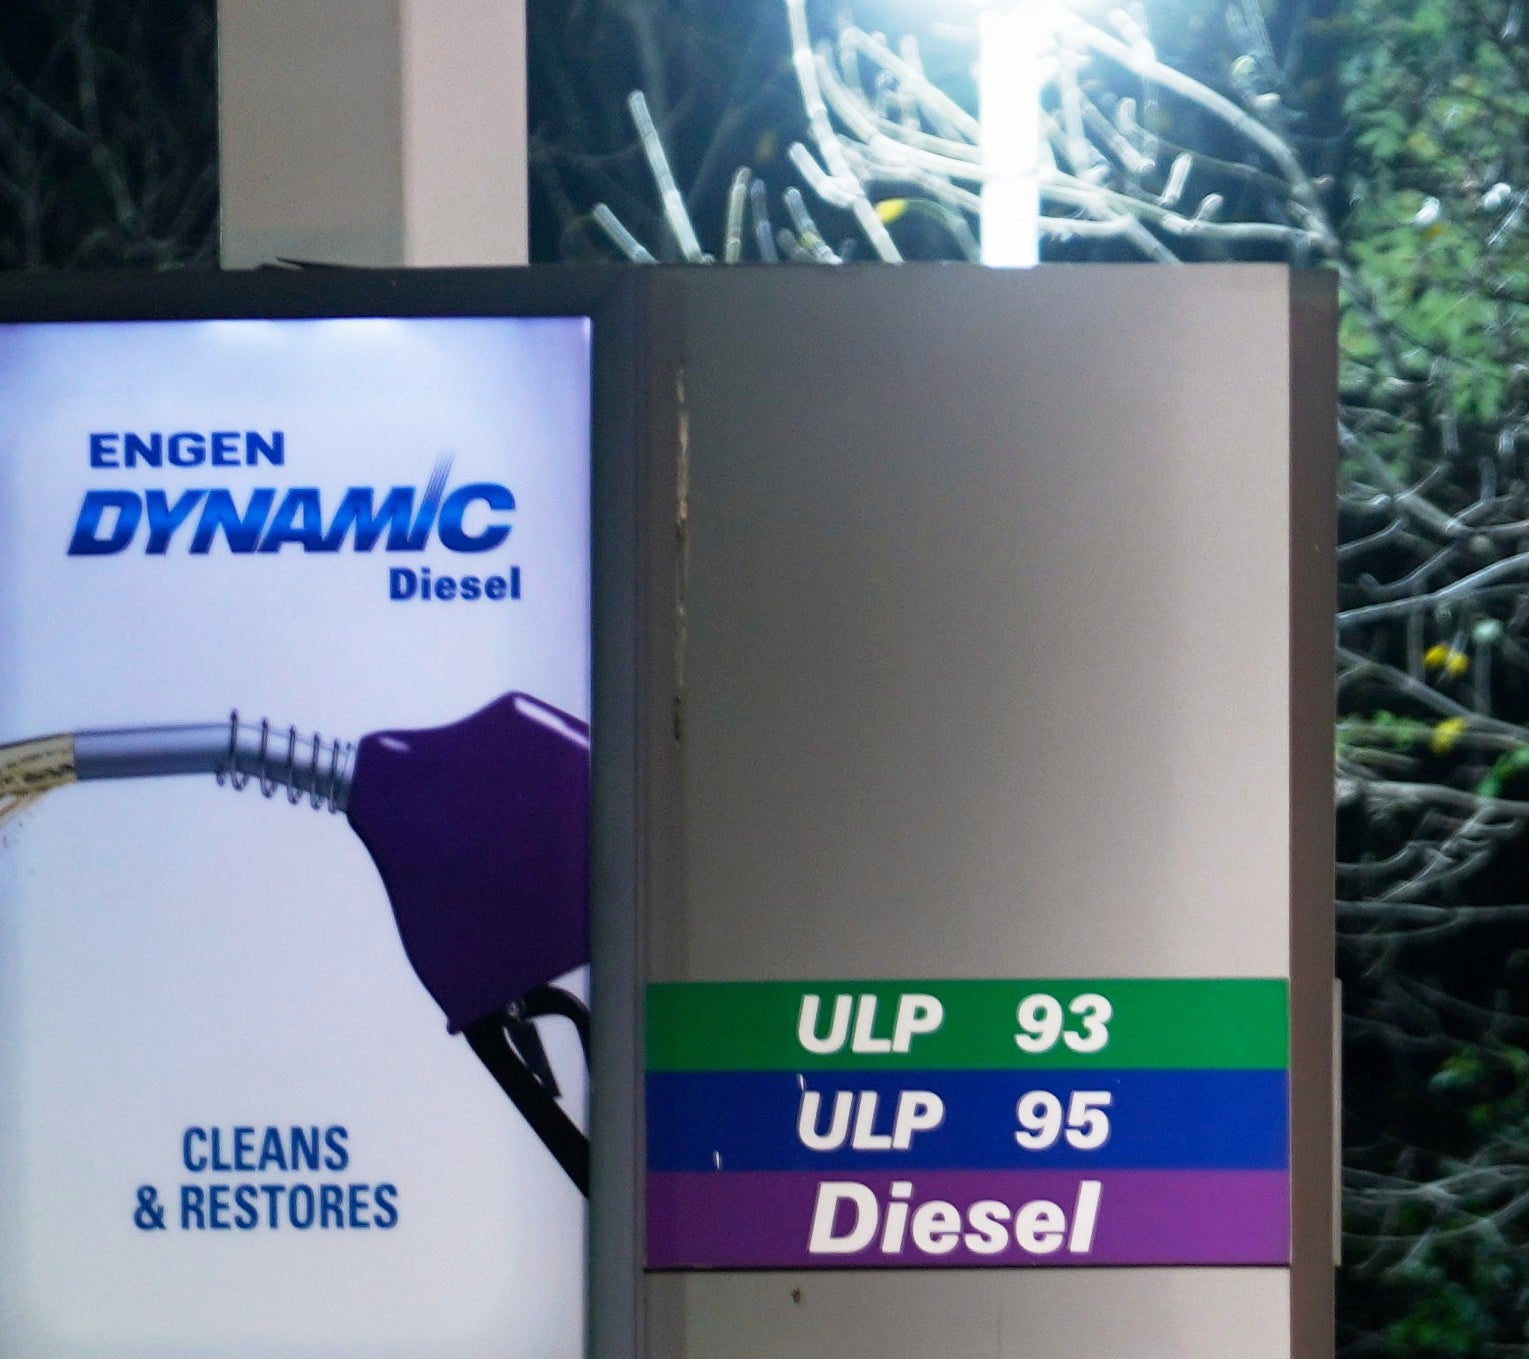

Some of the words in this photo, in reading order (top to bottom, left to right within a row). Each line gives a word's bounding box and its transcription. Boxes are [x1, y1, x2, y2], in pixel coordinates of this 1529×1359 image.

[89, 431, 285, 468] ENGEN
[67, 472, 517, 559] DYNAMIC
[388, 566, 522, 601] Diesel
[797, 993, 944, 1055] ULP
[1013, 992, 1114, 1053] 93
[797, 1091, 944, 1150] ULP
[1013, 1090, 1114, 1149] 95
[181, 1126, 349, 1173] CLEANS
[133, 1186, 167, 1231] &
[179, 1183, 400, 1231] RESTORES
[807, 1179, 1102, 1254] Diesel
